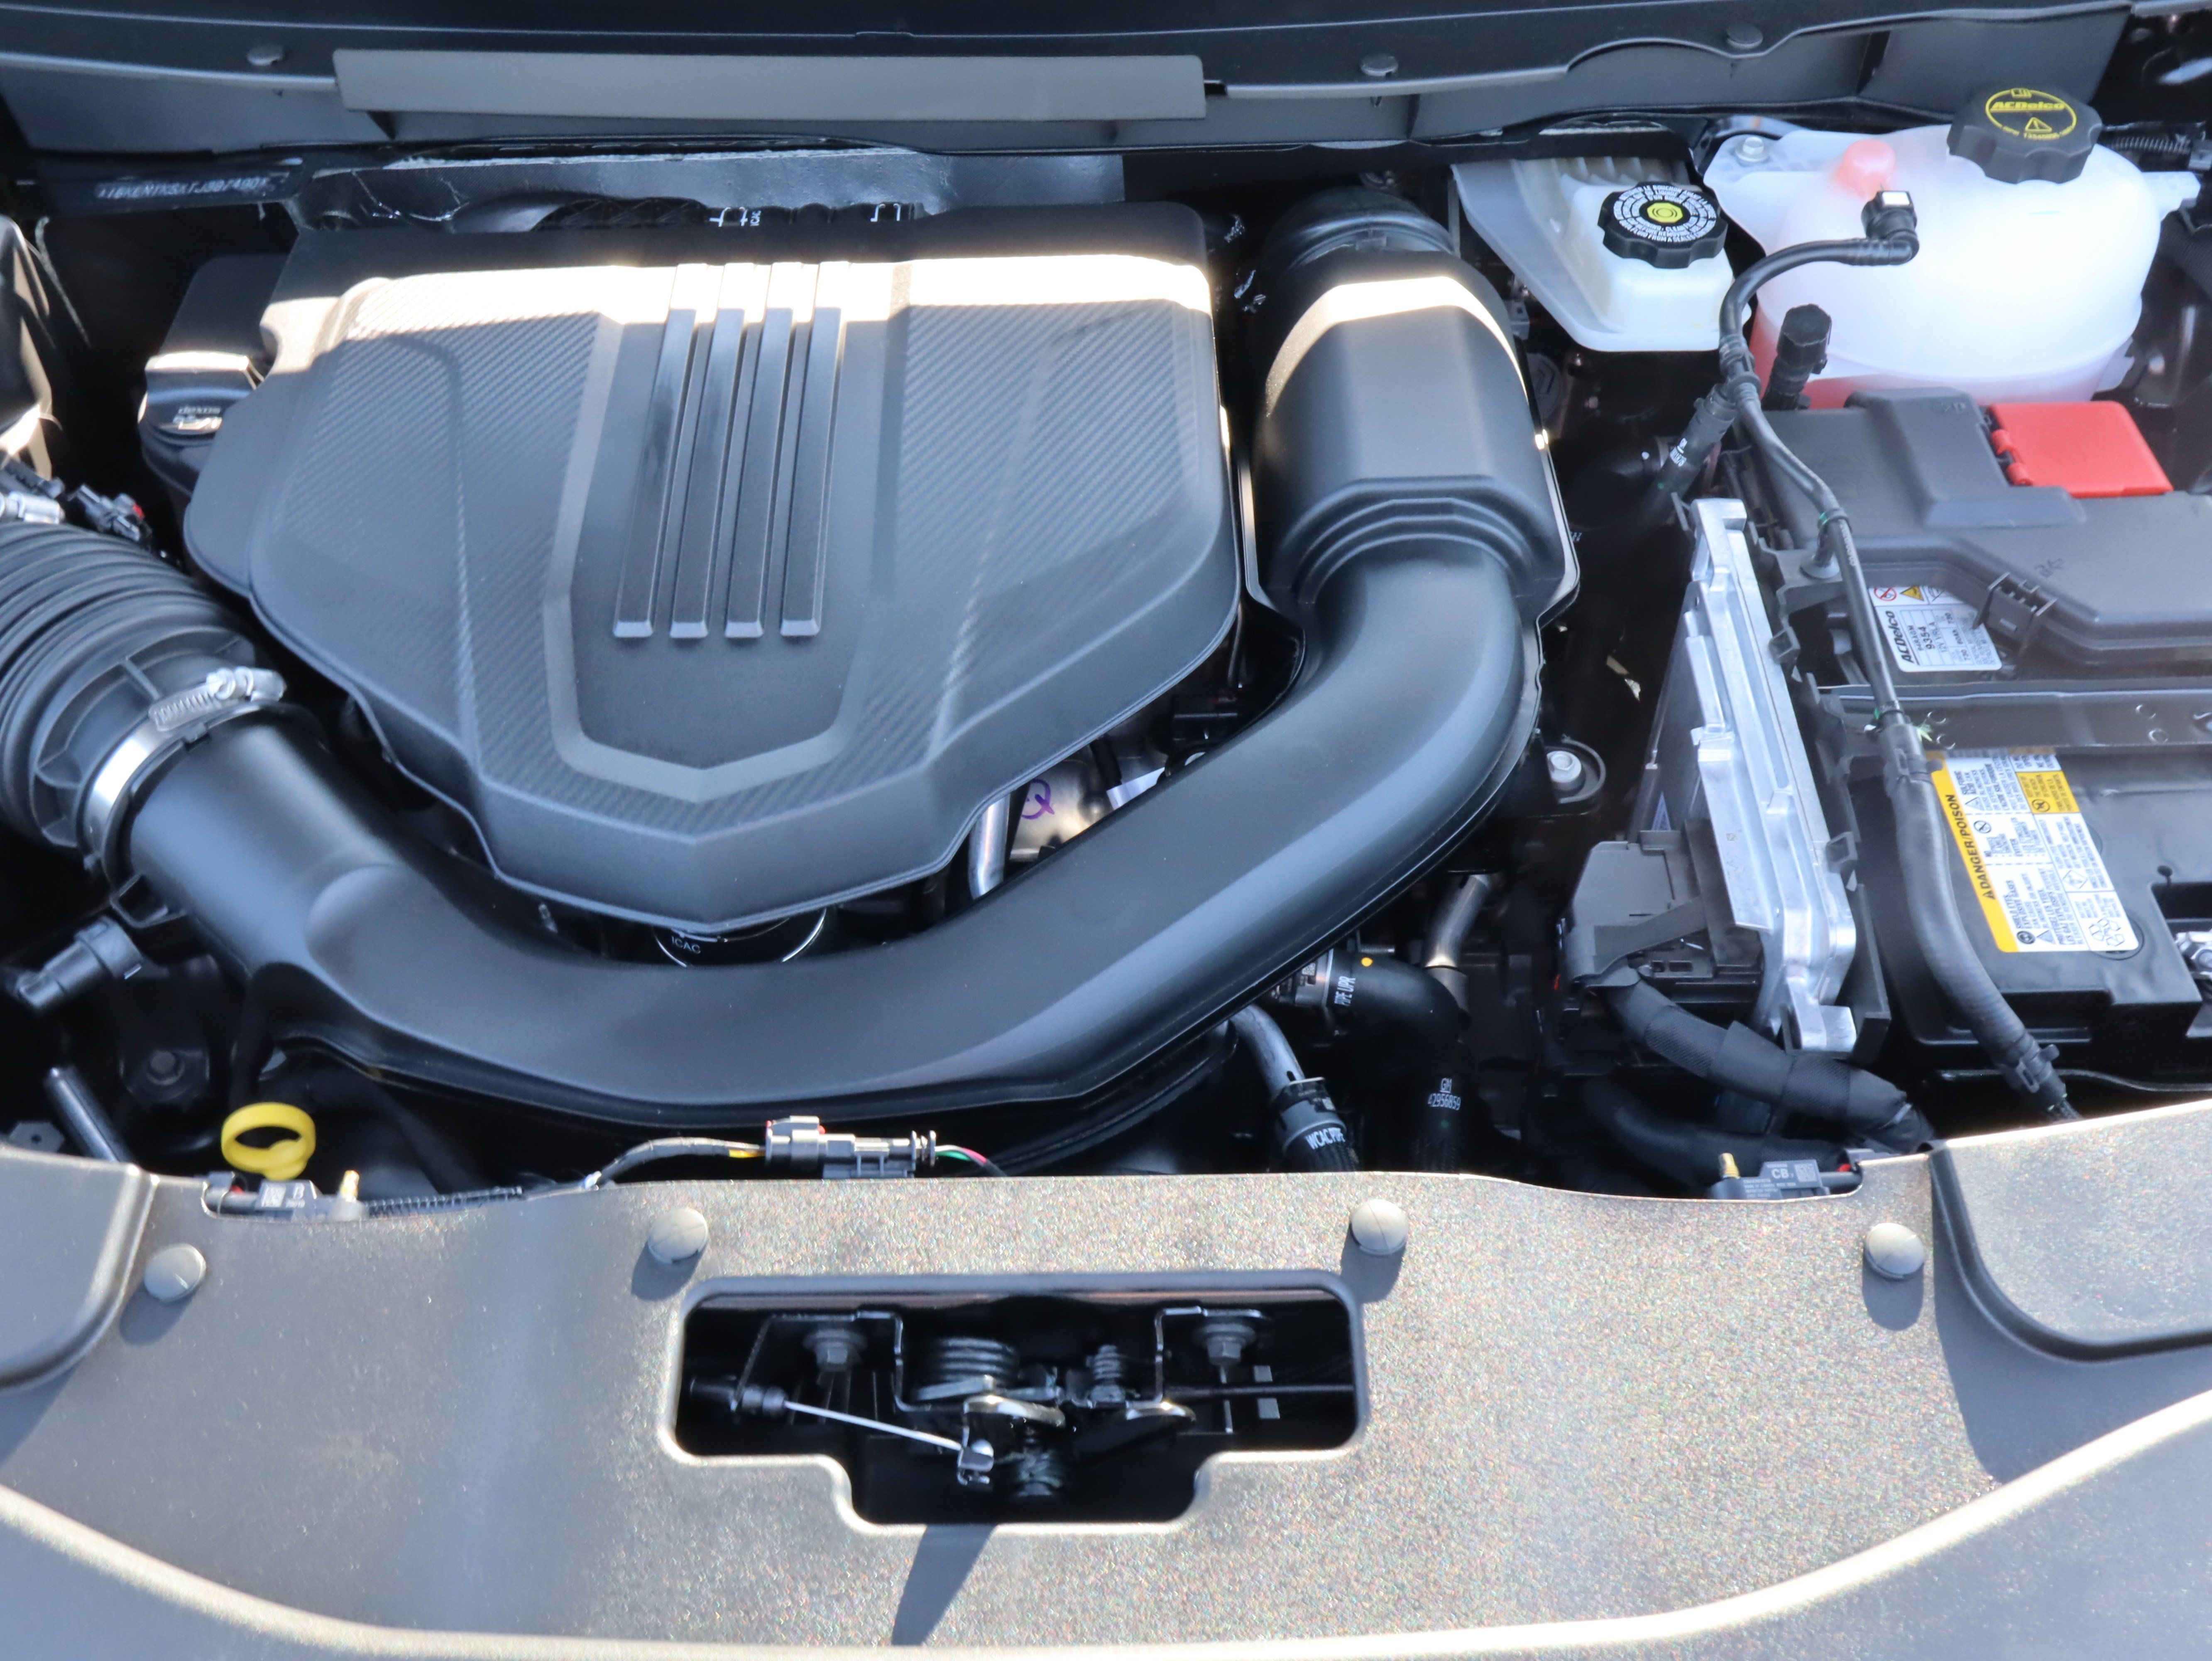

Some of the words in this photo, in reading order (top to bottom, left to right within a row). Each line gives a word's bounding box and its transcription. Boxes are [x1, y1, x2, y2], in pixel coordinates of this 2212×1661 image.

[1992, 101, 2066, 110] ACDelco
[1885, 610, 1914, 663] ACDelco
[1944, 794, 1992, 889] DANGER/POISON
[671, 936, 701, 954] ICAC
[1337, 976, 1356, 992] UPR
[1771, 1169, 1789, 1179] CB
